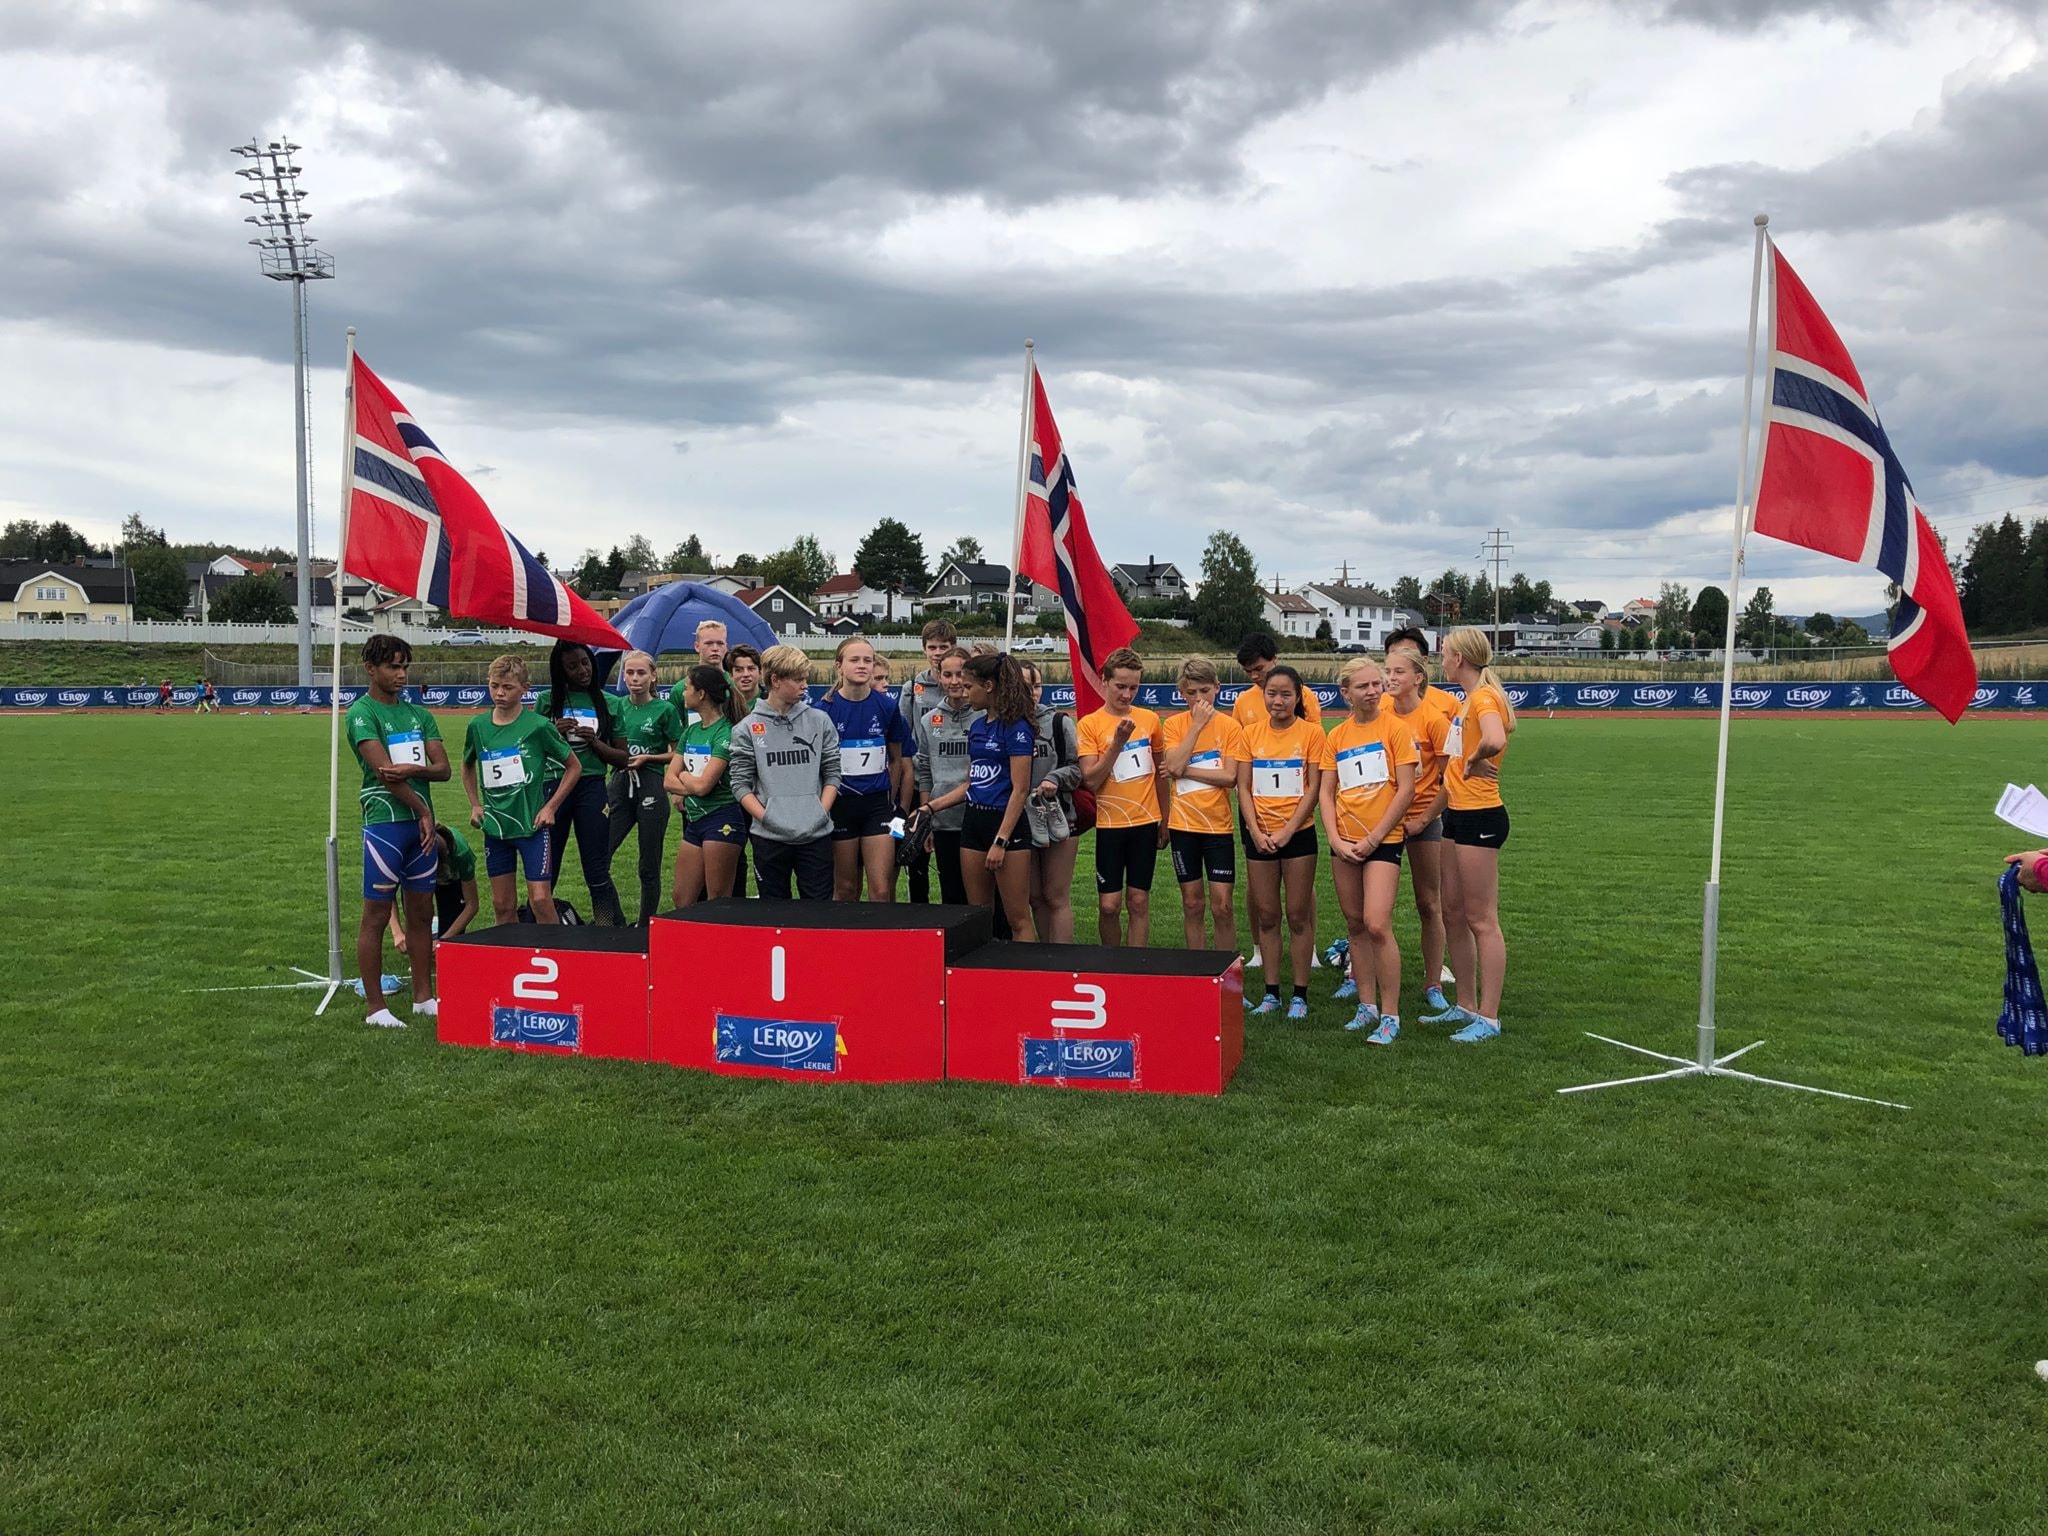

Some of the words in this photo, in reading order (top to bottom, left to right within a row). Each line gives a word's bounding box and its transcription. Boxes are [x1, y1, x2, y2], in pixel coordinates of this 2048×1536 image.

[15, 692, 46, 701] LERØY
[58, 692, 88, 701] LERØY
[128, 692, 157, 701] LERØY
[173, 692, 198, 701] ERØY
[233, 691, 260, 701] LERØY
[271, 691, 298, 701] LERØY
[458, 690, 484, 701] LERØY
[1052, 690, 1076, 700] LERØ
[1219, 691, 1239, 701] LER
[1577, 689, 1617, 701] LERØY
[1634, 689, 1675, 701] LERØY
[1786, 690, 1830, 701] LERØY
[412, 746, 421, 761] 5
[938, 741, 966, 756] PUM
[766, 749, 810, 767] PUMA
[860, 752, 870, 767] 7
[1131, 753, 1141, 768] 1
[1376, 752, 1382, 760] 7
[492, 765, 502, 779] 5
[688, 759, 695, 772] 5
[969, 765, 998, 779] ERØY
[1354, 760, 1363, 776] 1
[1272, 773, 1279, 788] 1
[513, 957, 559, 1000] 2
[772, 946, 785, 1001] 1
[1051, 984, 1107, 1029] 3
[524, 1016, 566, 1031] LERØY
[754, 1028, 818, 1048] LERØY
[1065, 1046, 1118, 1061] LERØY
[804, 1062, 832, 1071] LEKENE
